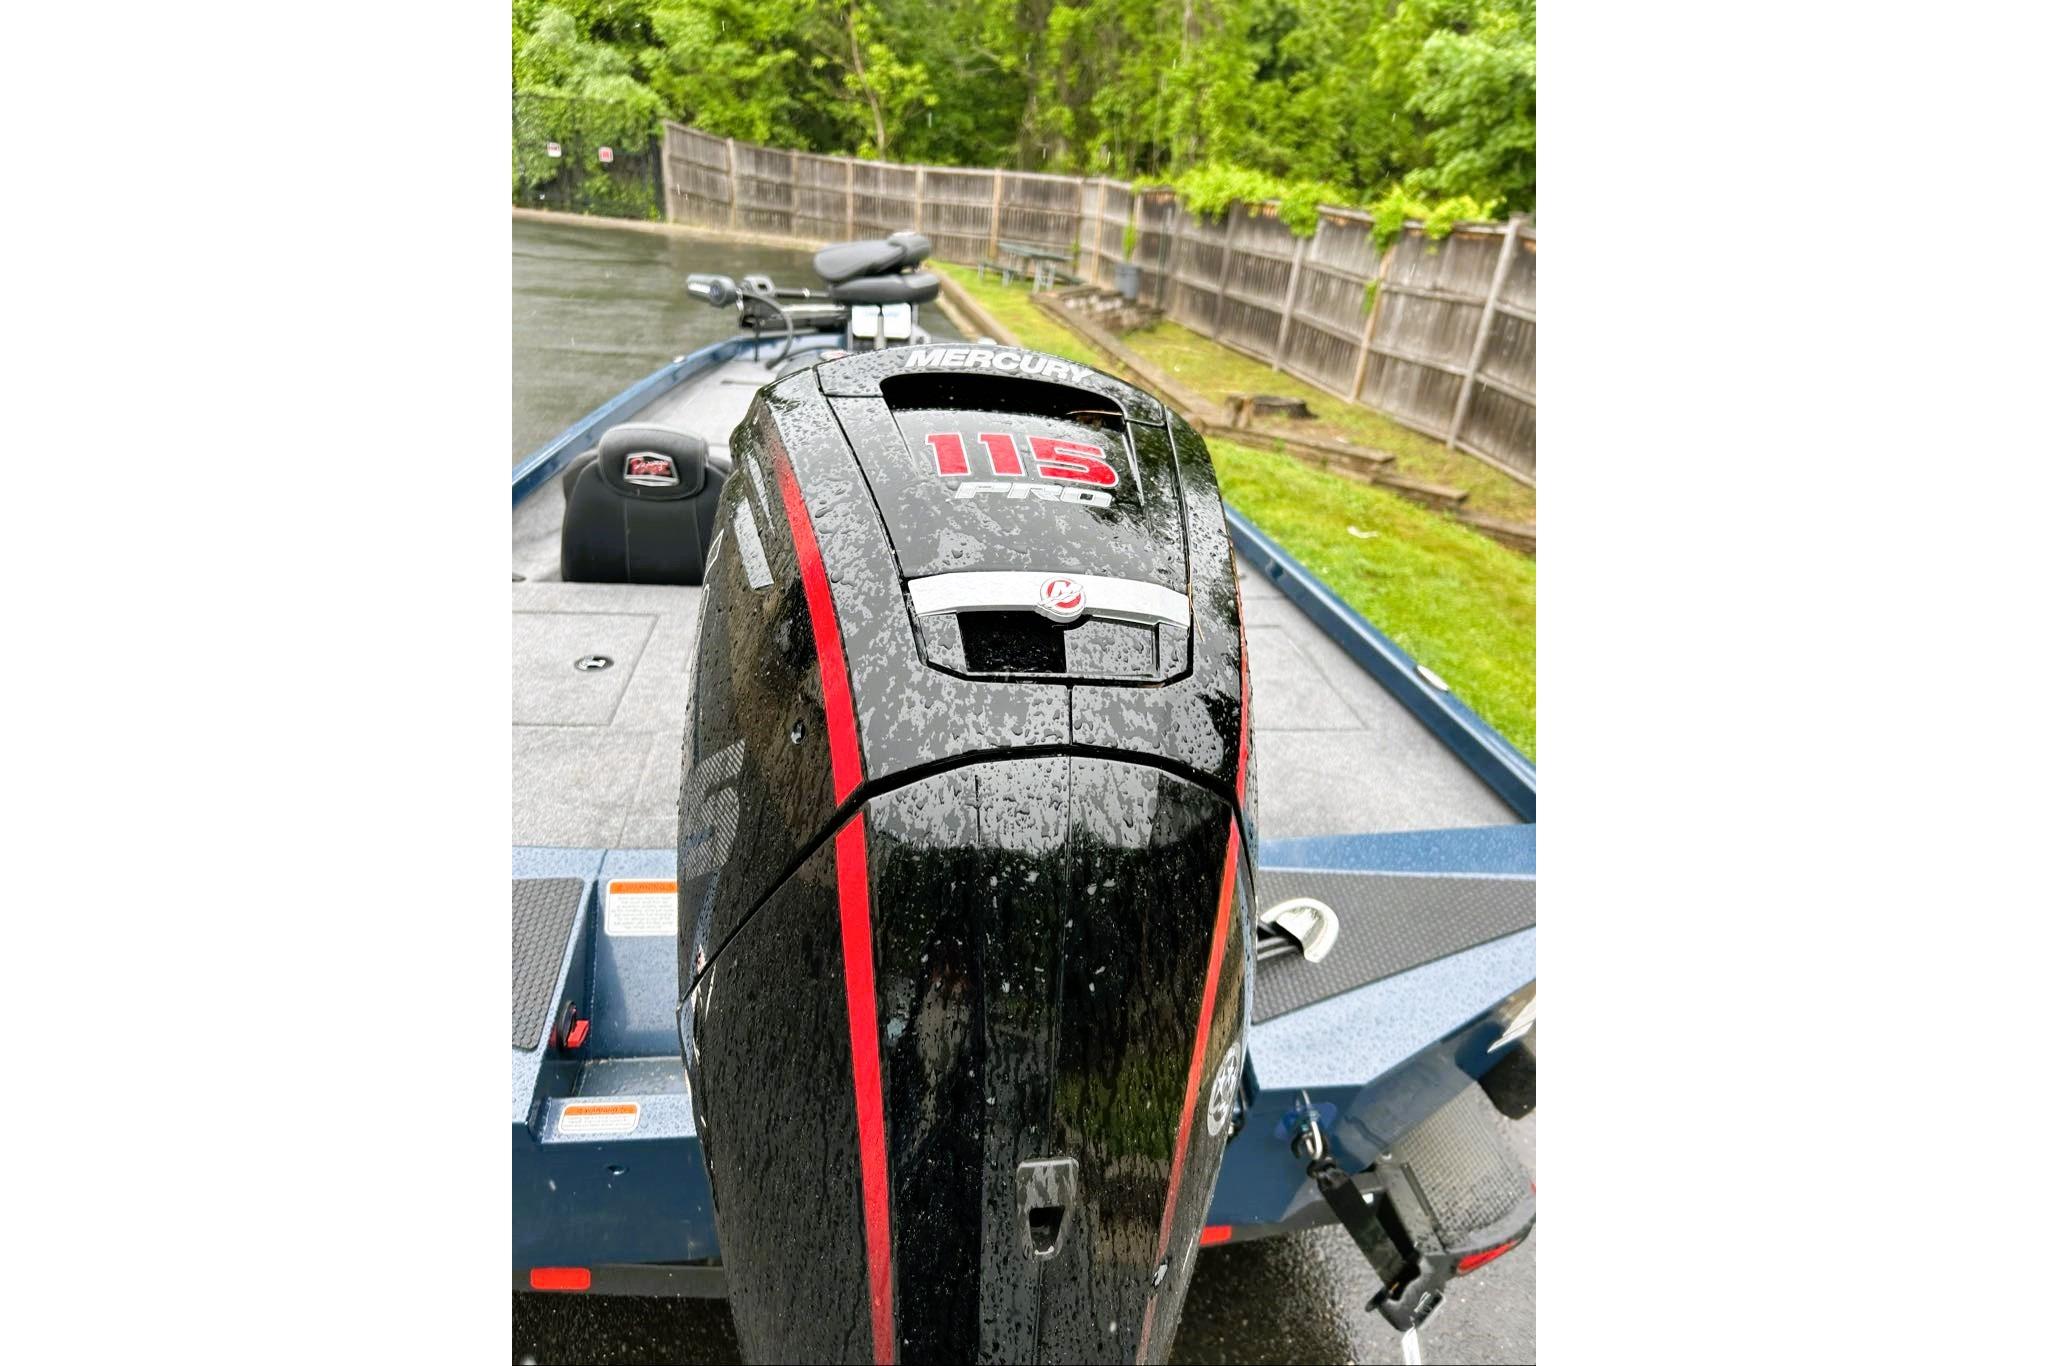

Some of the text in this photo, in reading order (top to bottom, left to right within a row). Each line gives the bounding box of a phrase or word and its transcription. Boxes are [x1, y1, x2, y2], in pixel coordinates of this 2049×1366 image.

[904, 349, 1095, 383] MERCURY
[925, 432, 1119, 488] 115
[954, 481, 1116, 508] PRO
